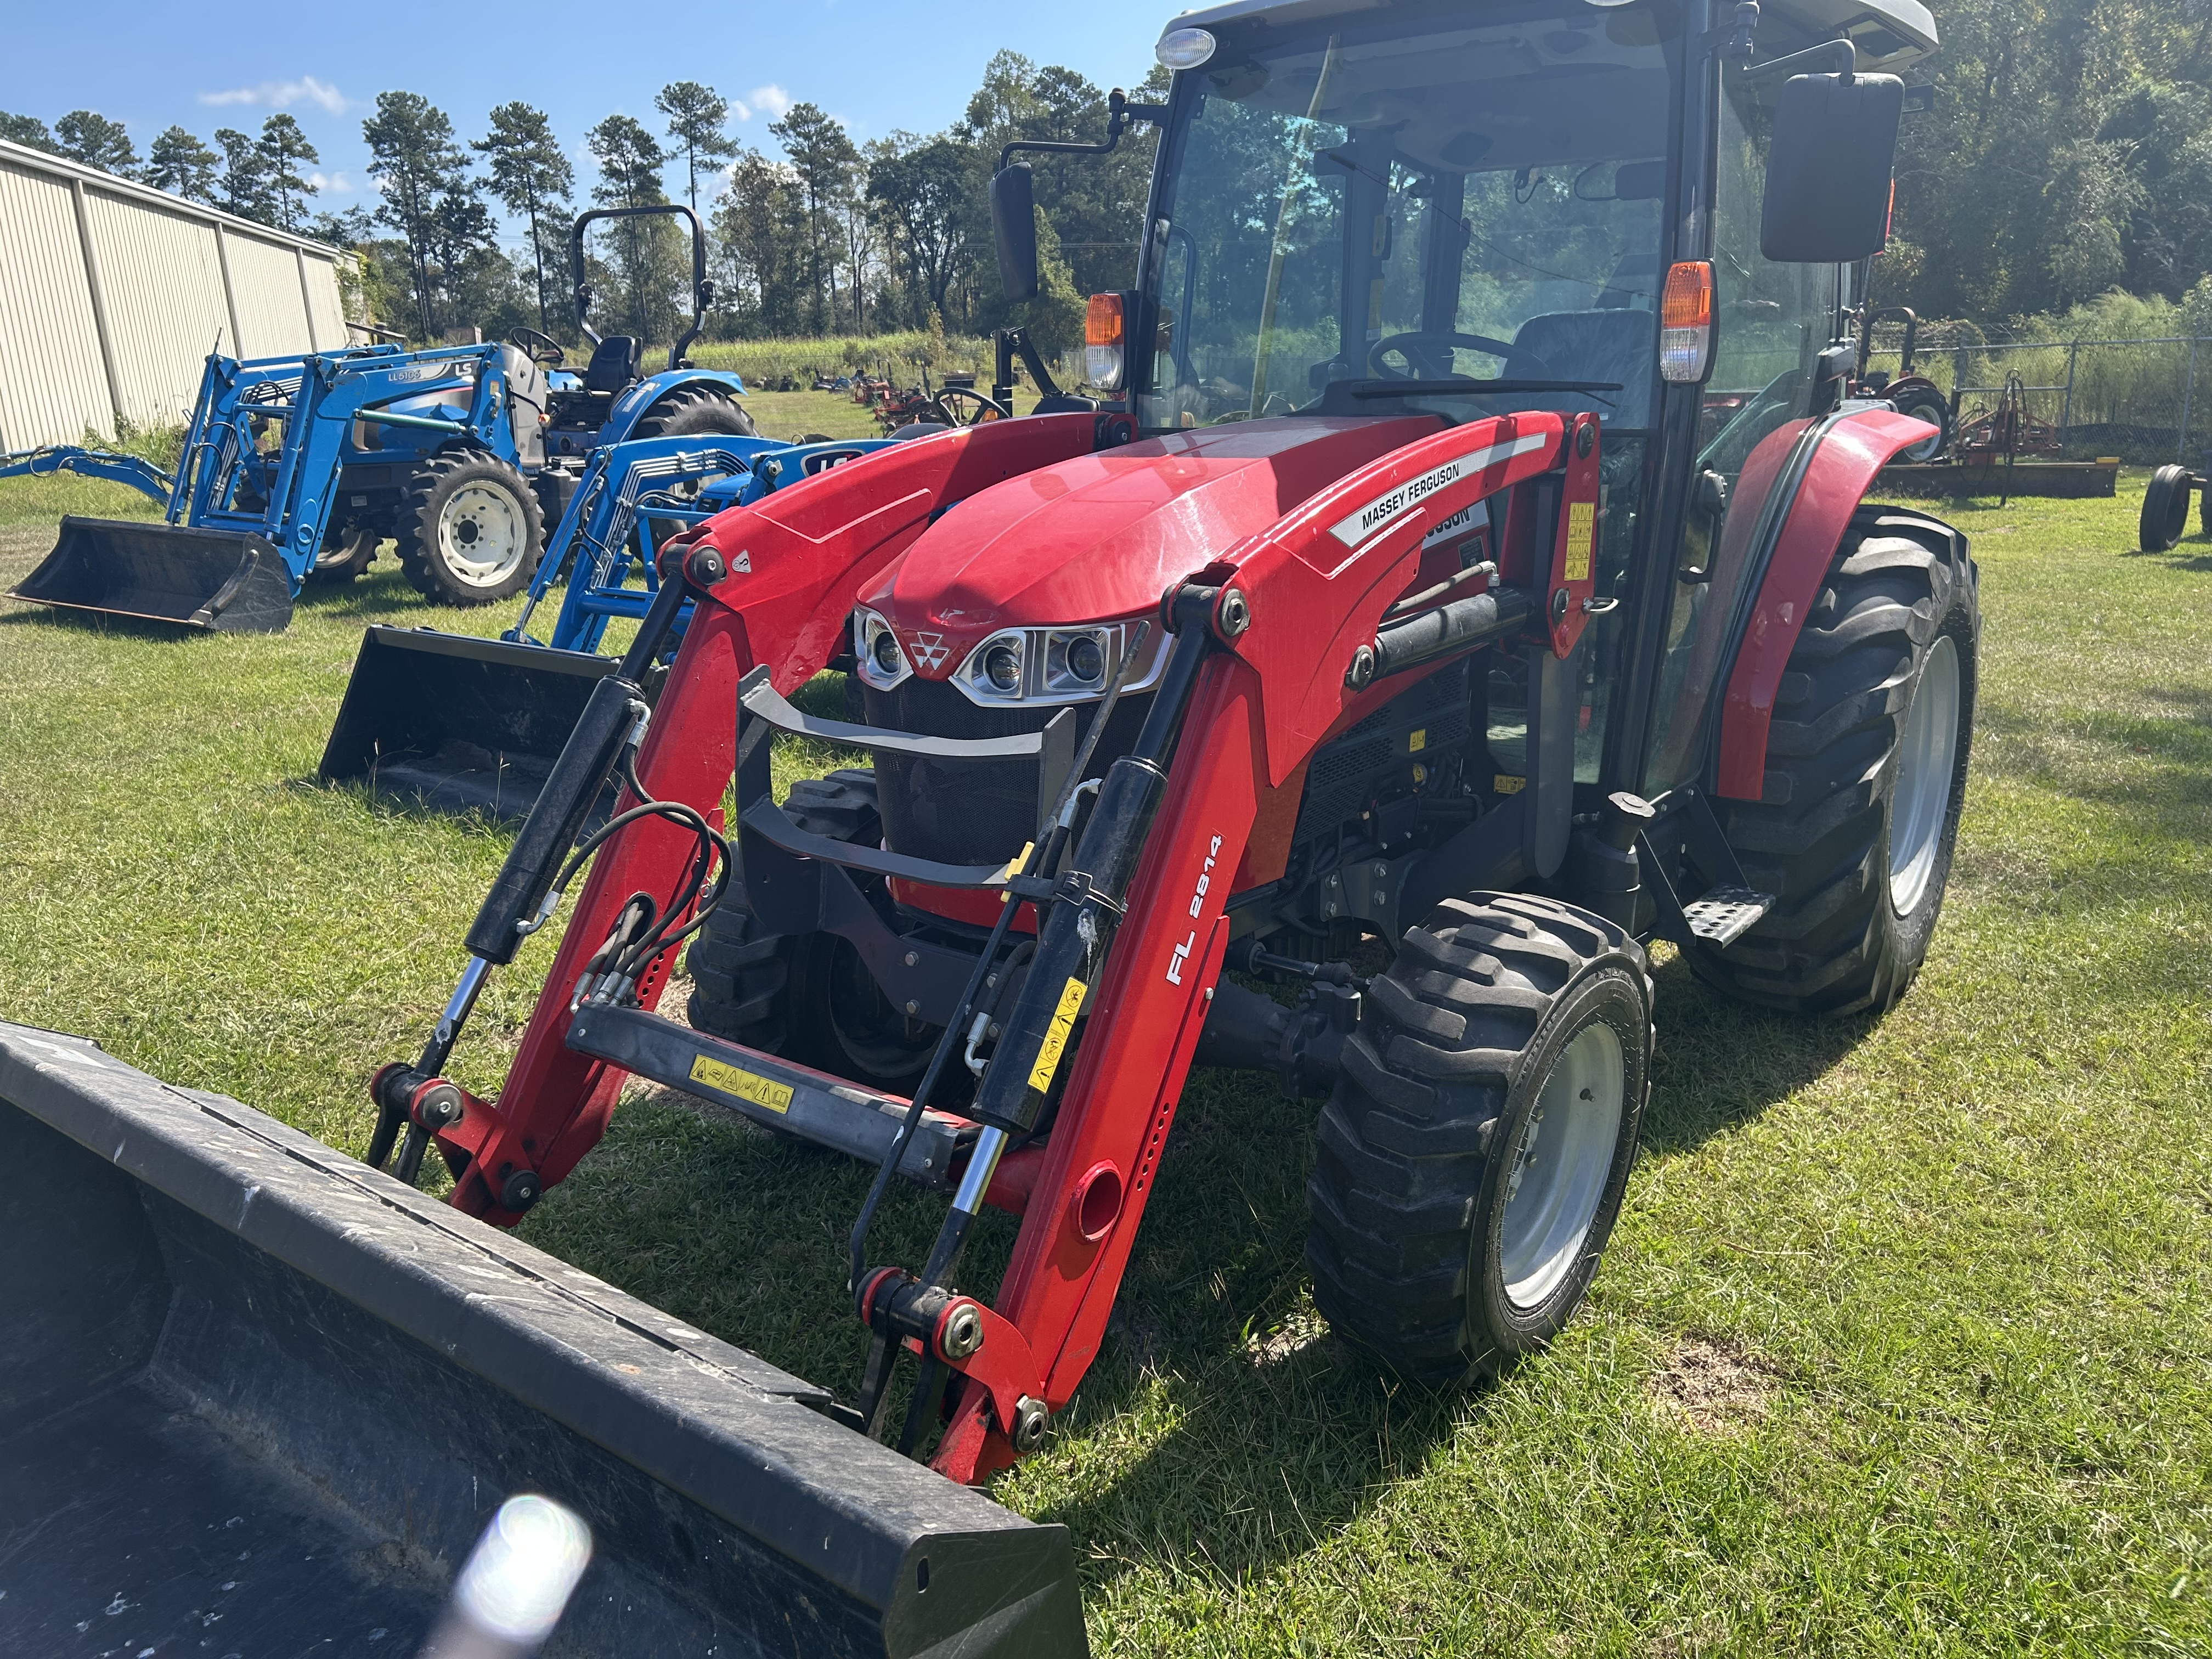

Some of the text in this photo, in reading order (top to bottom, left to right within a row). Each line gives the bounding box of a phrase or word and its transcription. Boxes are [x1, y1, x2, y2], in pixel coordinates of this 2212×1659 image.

[455, 363, 472, 376] LS
[1362, 462, 1460, 530] MASSEY FERGUSON
[1166, 834, 1222, 986] FL 2814
